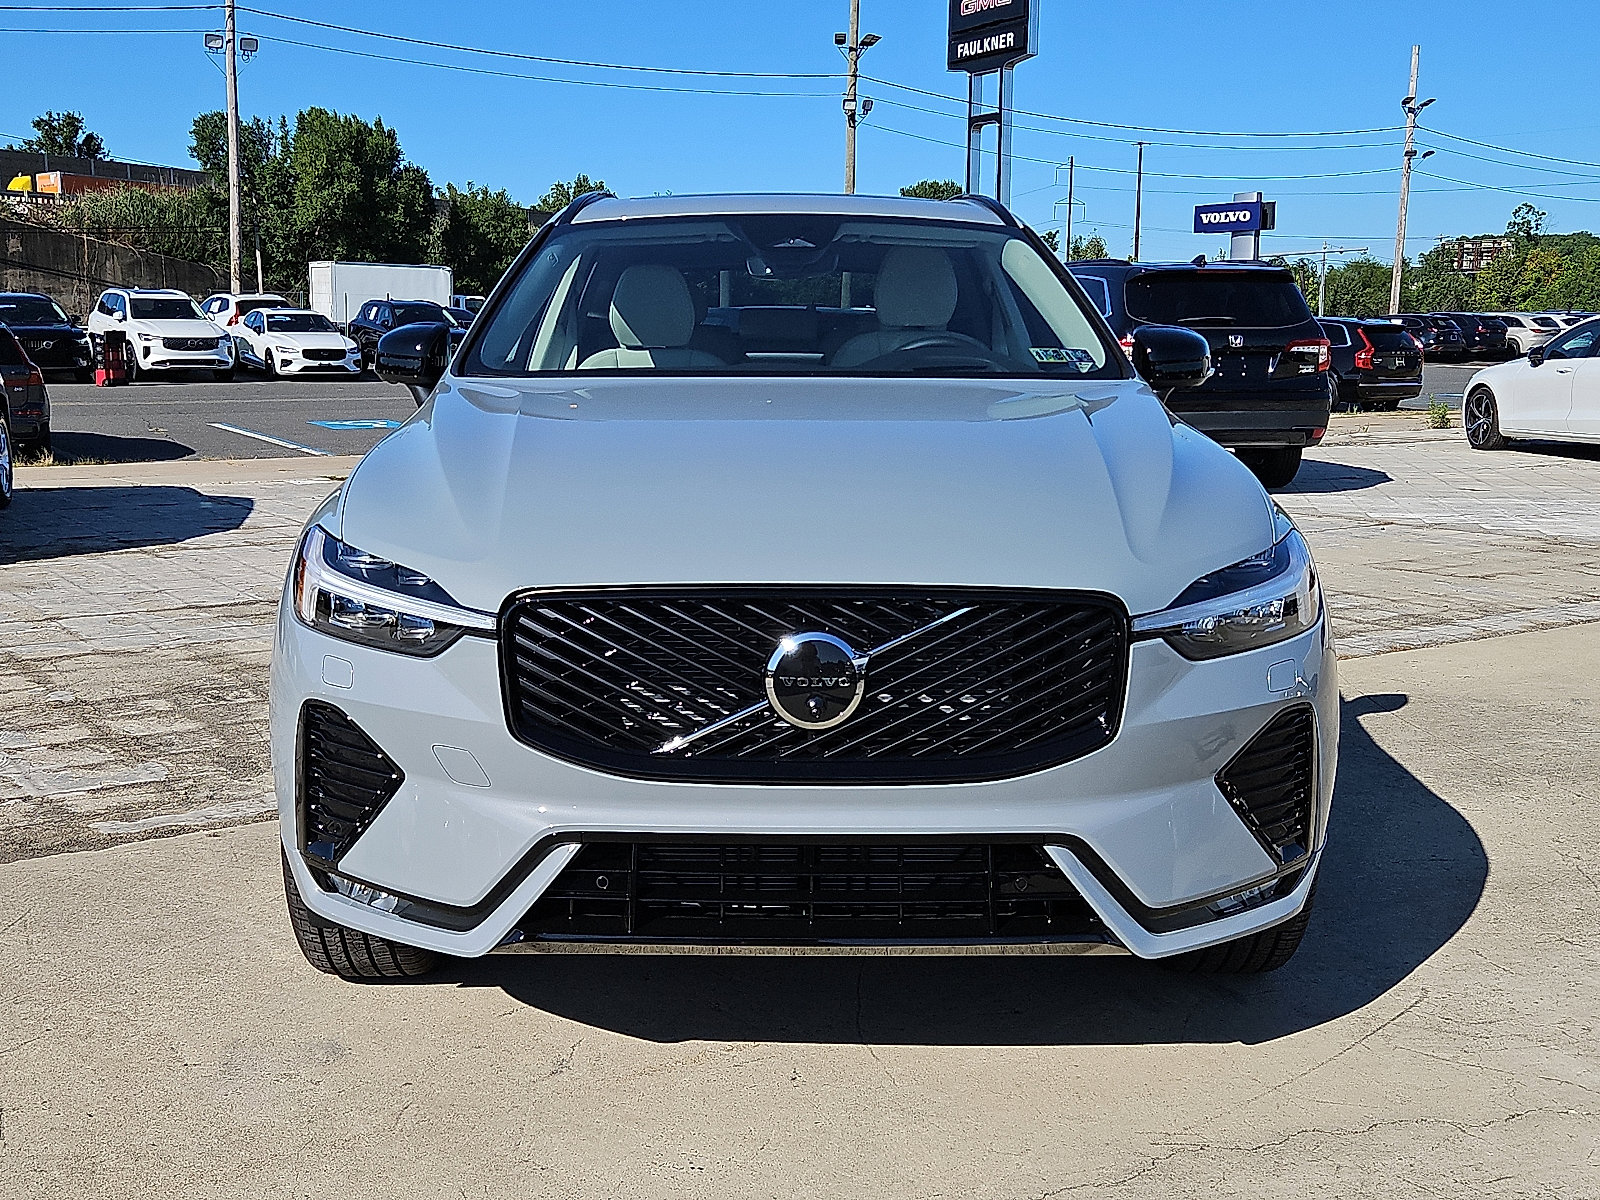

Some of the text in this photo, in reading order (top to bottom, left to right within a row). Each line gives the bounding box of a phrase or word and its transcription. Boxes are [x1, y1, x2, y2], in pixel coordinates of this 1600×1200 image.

[957, 32, 1015, 58] FAULKNER
[1200, 210, 1251, 224] VOLVO
[779, 676, 851, 688] VOLVO
